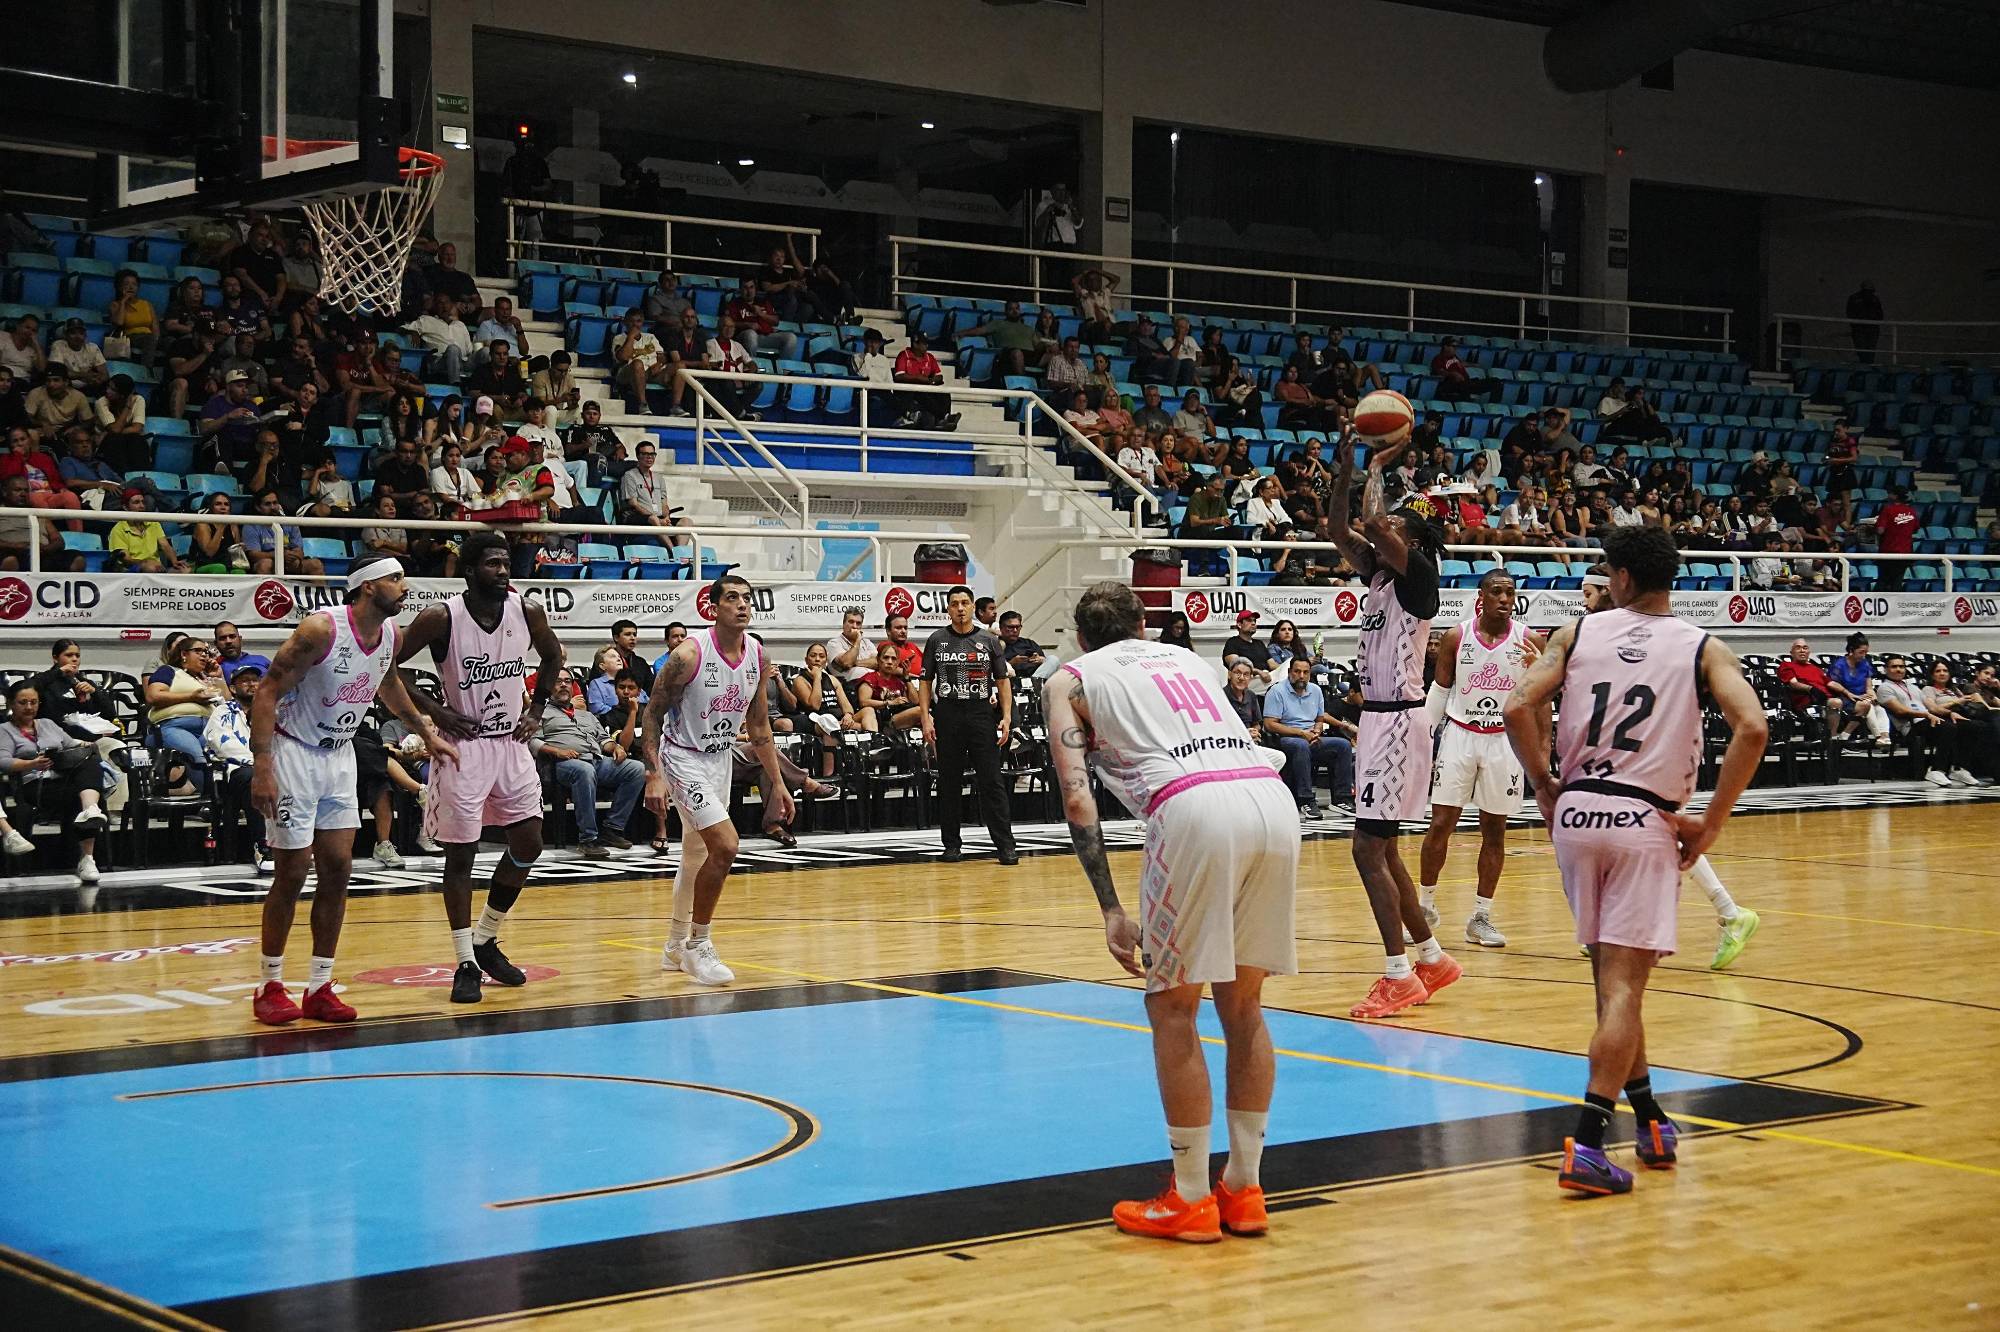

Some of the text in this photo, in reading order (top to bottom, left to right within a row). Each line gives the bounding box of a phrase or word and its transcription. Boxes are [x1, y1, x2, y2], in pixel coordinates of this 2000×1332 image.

[36, 580, 101, 609] CID
[123, 587, 235, 599] SIEMPRE GRANDES
[592, 592, 681, 602] SIEMPRE GRANDES
[790, 593, 872, 602] SIEMPRE GRANDES
[131, 600, 226, 611] SIEMPRE LOBOS
[1210, 591, 1247, 613] UAD
[1289, 597, 1323, 605] GRANDES
[1440, 600, 1464, 608] ANDES
[1691, 600, 1719, 608] GRANDES
[1748, 596, 1776, 616] UAD
[1863, 597, 1889, 617] CID
[1970, 598, 1999, 616] UAD
[599, 604, 674, 614] SIEMPRE LOBOS
[797, 605, 836, 614] SIEMPRE
[1294, 607, 1318, 615] LOBOS
[1695, 610, 1715, 618] LOBOS
[459, 652, 525, 690] Tsunami
[1461, 672, 1517, 695] Puerto
[1151, 672, 1223, 724] 44
[1585, 681, 1657, 753] 12
[317, 721, 344, 733] Banco
[1360, 782, 1375, 808] 4
[1561, 807, 1653, 829] Comex
